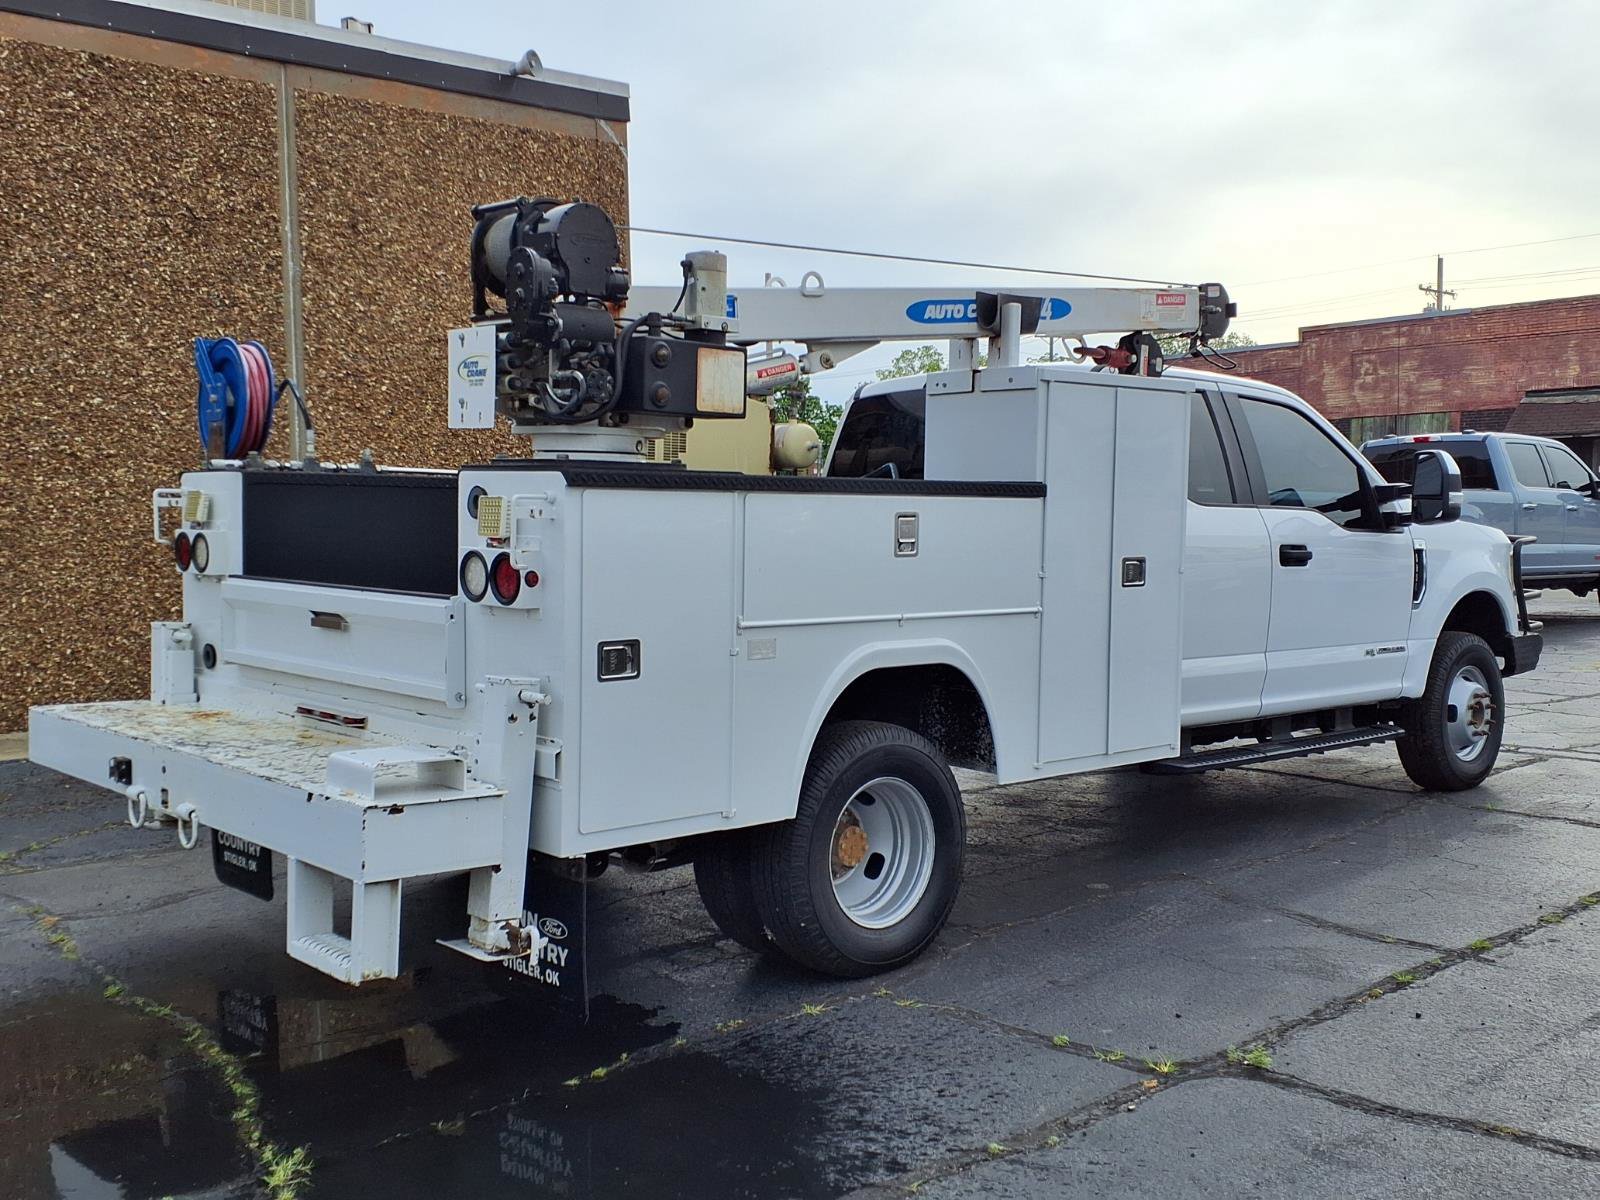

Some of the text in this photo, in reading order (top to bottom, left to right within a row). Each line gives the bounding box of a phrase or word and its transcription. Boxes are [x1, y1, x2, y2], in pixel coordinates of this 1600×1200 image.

[1163, 295, 1185, 304] DANGER
[923, 303, 965, 320] AUTO
[463, 360, 479, 369] AUTO
[767, 364, 793, 375] DANGER
[466, 368, 487, 377] CRANE
[544, 920, 562, 936] Ford
[545, 968, 560, 987] OK
